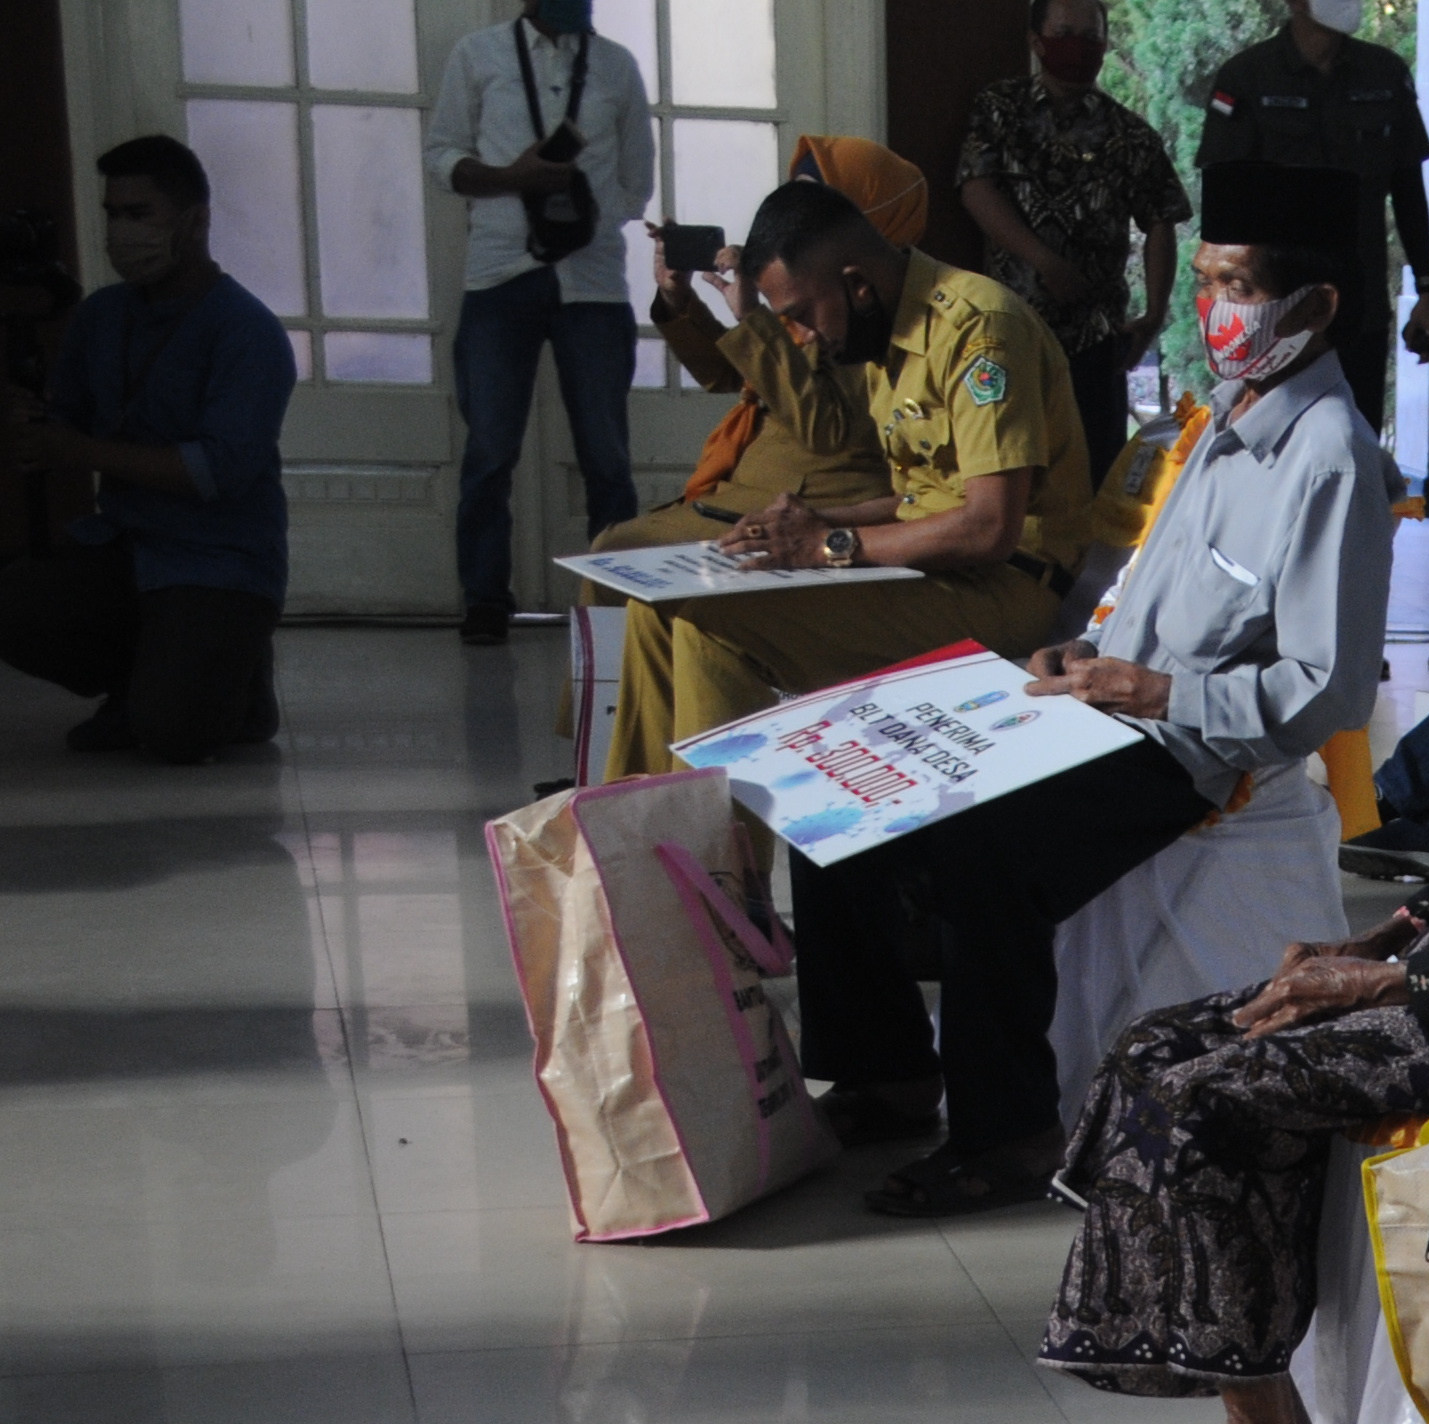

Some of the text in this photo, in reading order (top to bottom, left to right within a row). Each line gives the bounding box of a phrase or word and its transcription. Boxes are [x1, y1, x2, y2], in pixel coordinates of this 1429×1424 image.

[849, 702, 979, 783] BLT DANA DESA
[905, 702, 996, 755] PENERIMA
